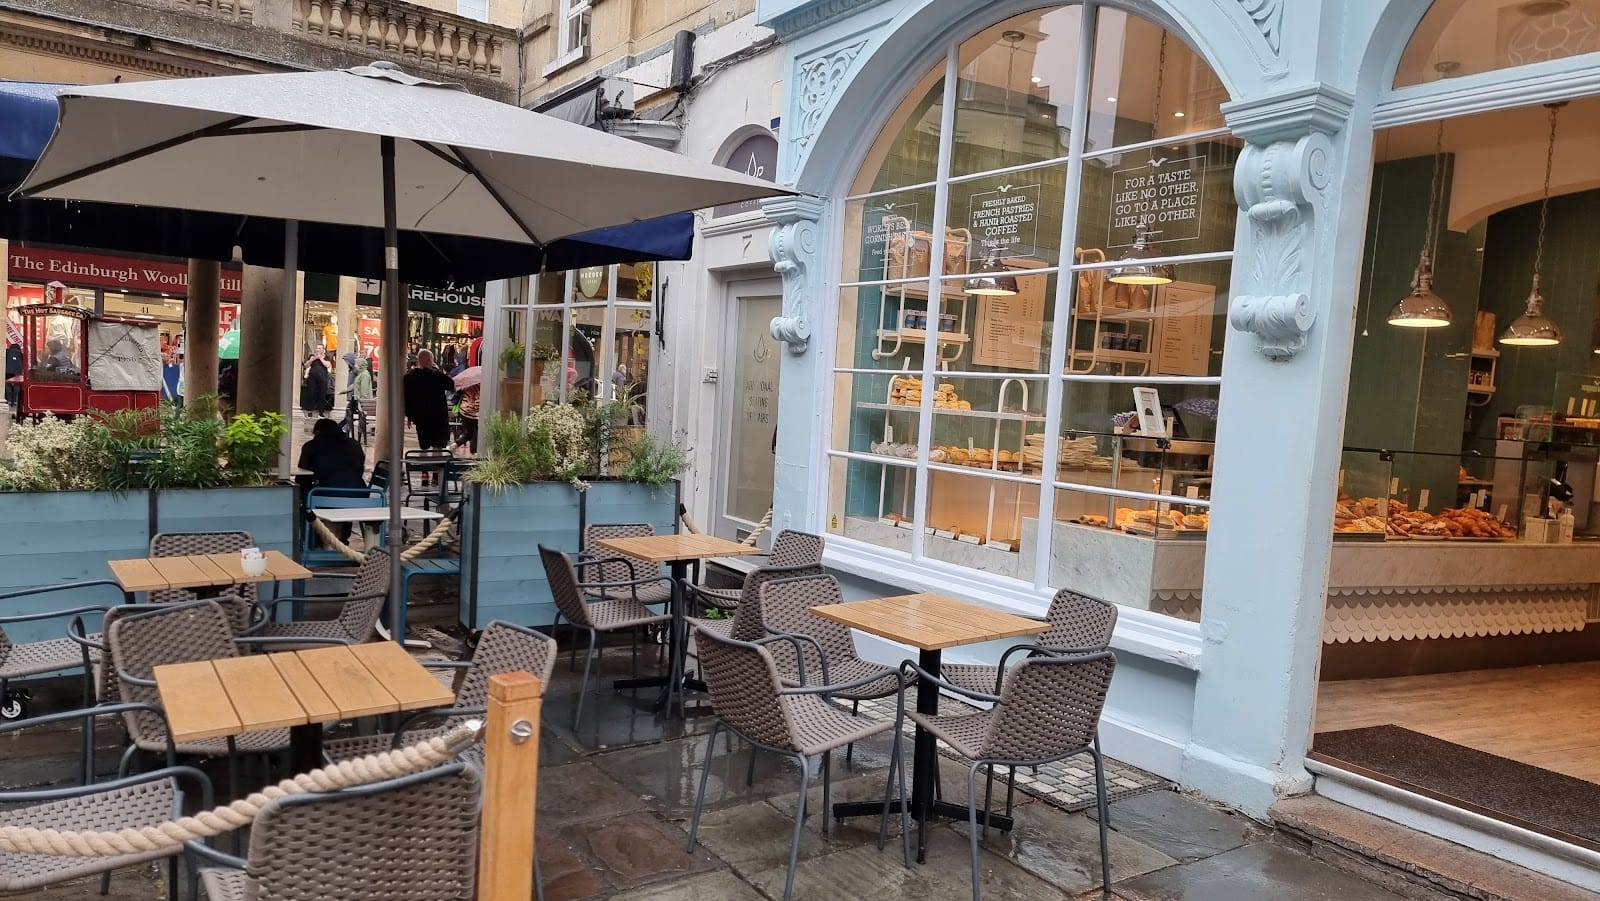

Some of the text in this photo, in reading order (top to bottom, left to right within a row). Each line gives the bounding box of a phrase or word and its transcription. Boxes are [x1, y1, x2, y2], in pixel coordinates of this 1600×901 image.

[1125, 169, 1192, 189] FOR A TASTE
[982, 195, 1026, 208] FRESHLY BAKED
[1115, 181, 1199, 203] LIKE NO OTHER,
[973, 203, 1035, 219] FRENCH PASTRIES
[1115, 194, 1198, 215] GO TO A PLACE
[980, 218, 999, 227] HAND
[1000, 213, 1033, 225] ROASTED
[1115, 208, 1196, 228] LIKE NO OTHER
[985, 224, 1018, 236] COFFEE
[10, 255, 242, 291] The Edinburgh Wooll ill
[408, 289, 486, 307] REHOUSE
